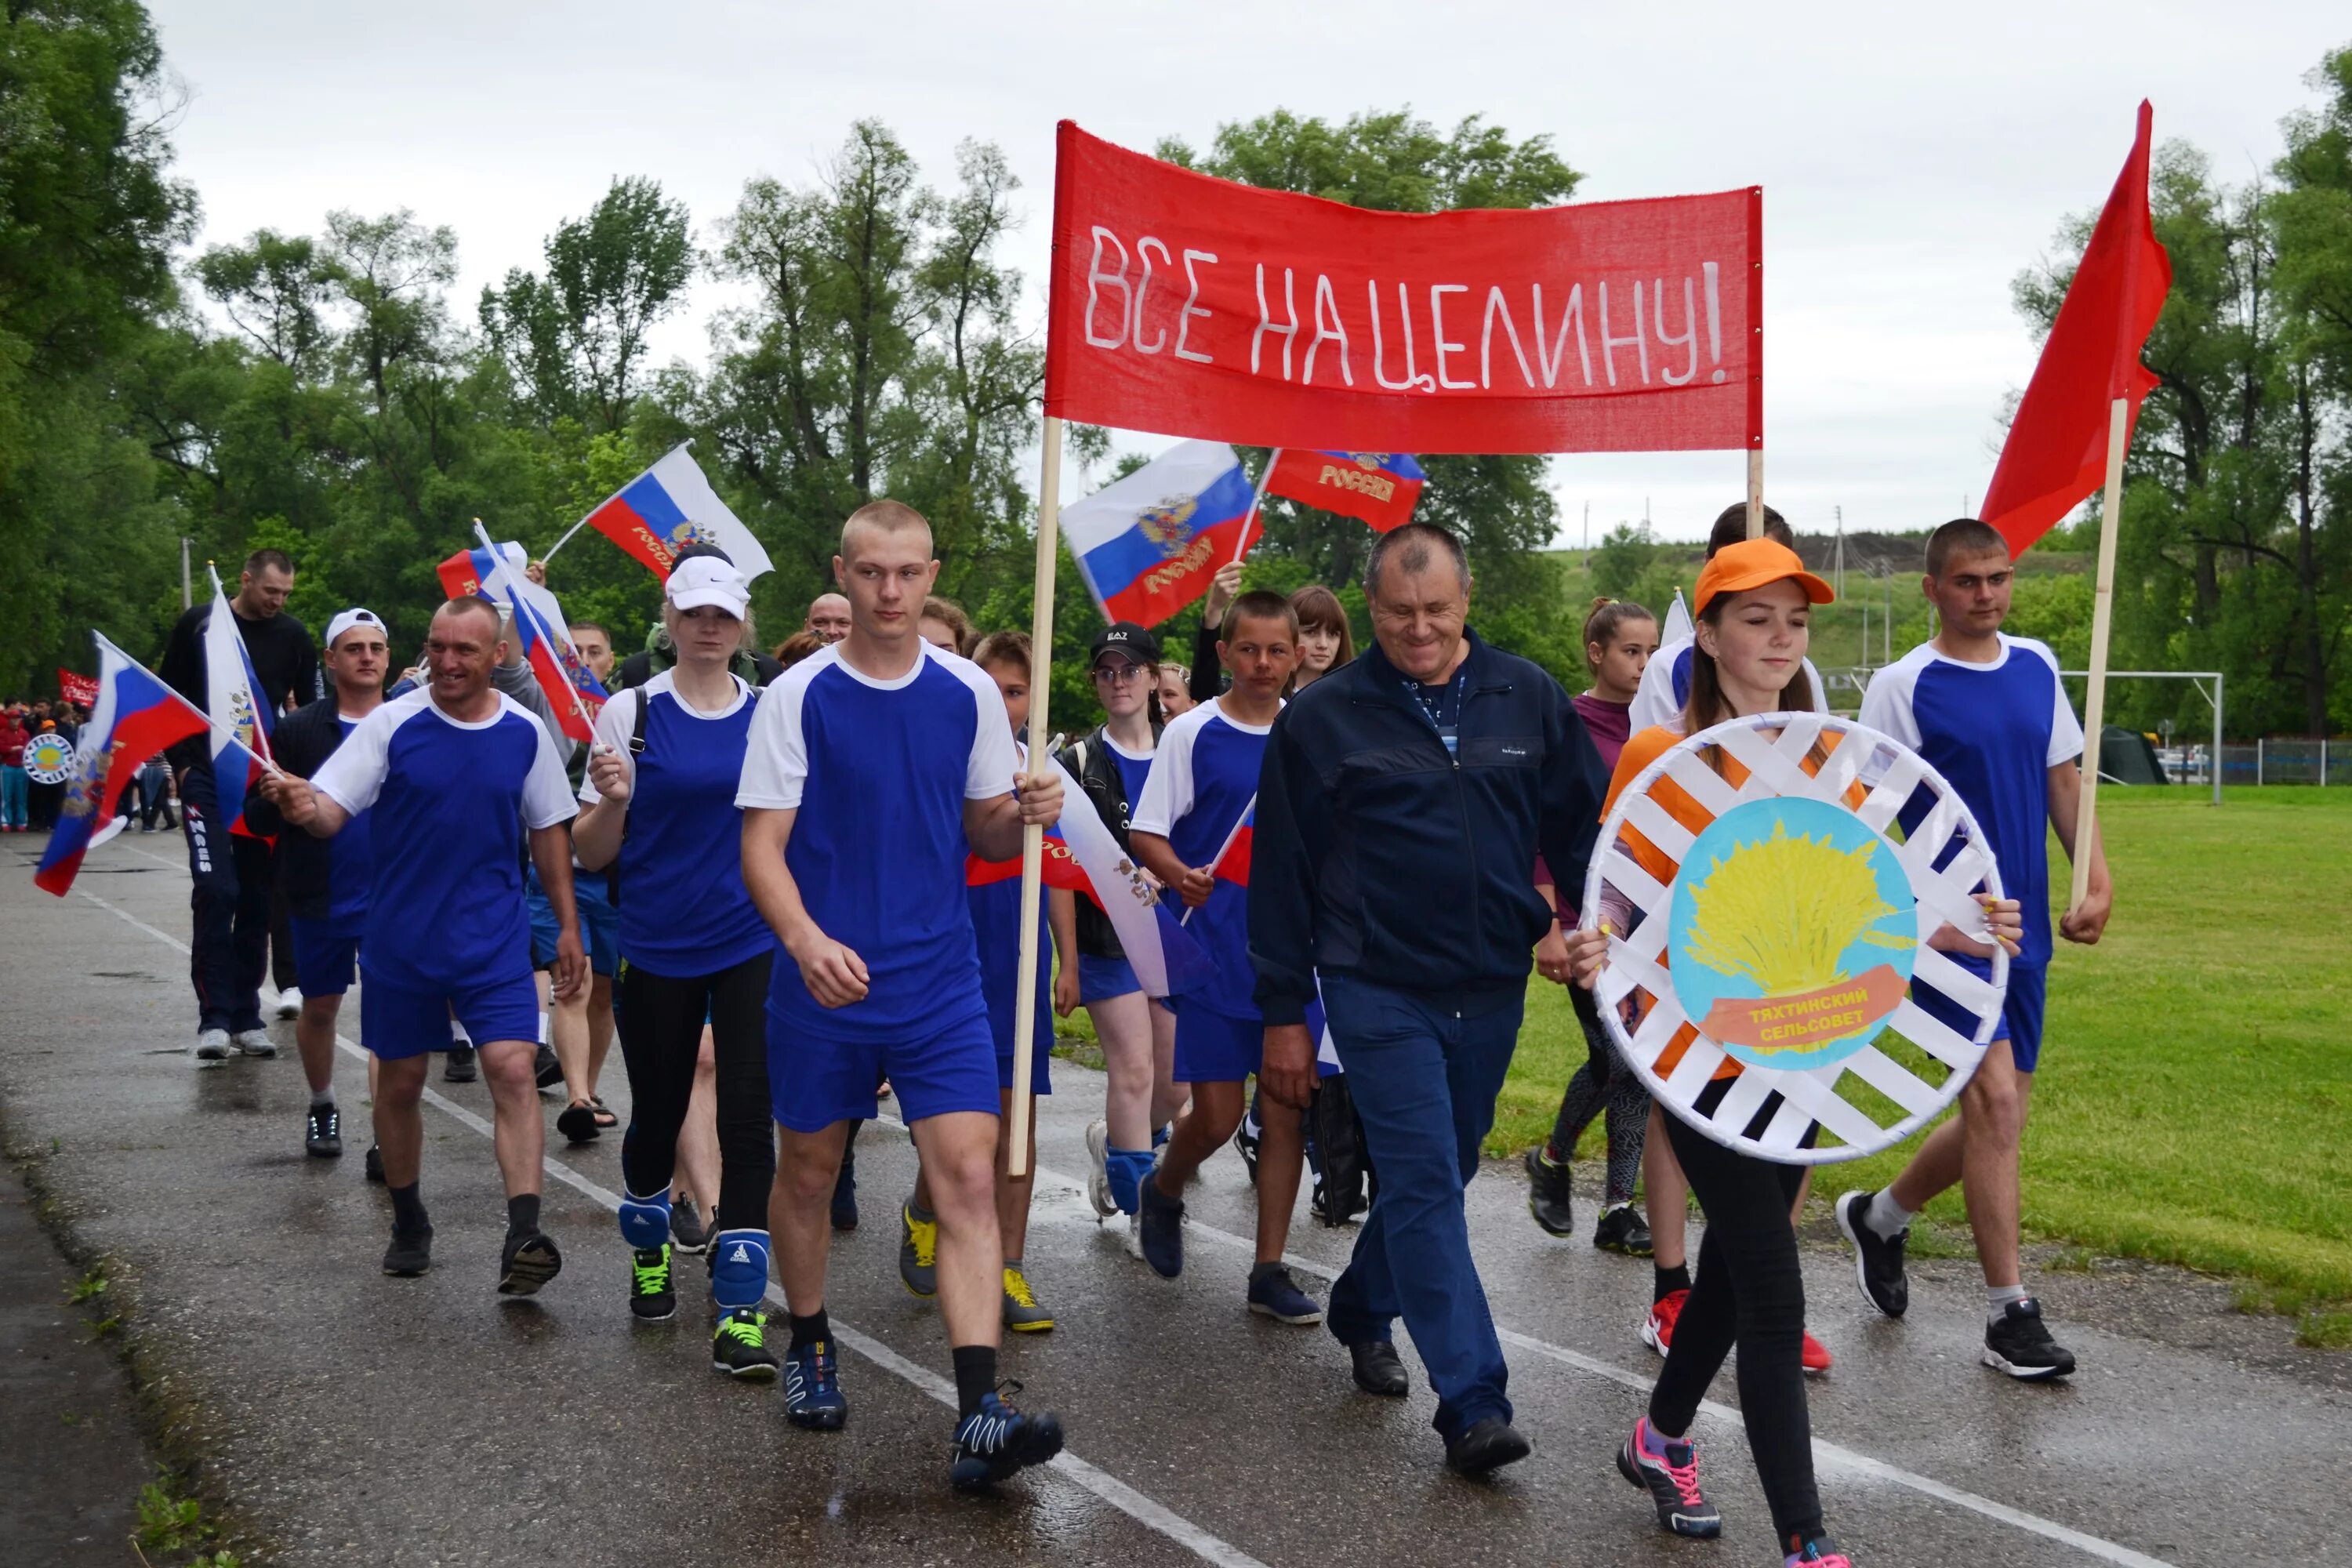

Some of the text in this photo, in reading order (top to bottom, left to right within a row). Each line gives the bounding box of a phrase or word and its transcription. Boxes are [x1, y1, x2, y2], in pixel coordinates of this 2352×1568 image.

[1085, 225, 1218, 364] ВСЕ
[1317, 464, 1396, 503] РОССИЯ
[630, 526, 673, 572] РОССИ
[1748, 986, 1869, 1024] ТЯХТИНСКИЙ
[1759, 1009, 1864, 1042] СЕЛЬСОВЕТ
